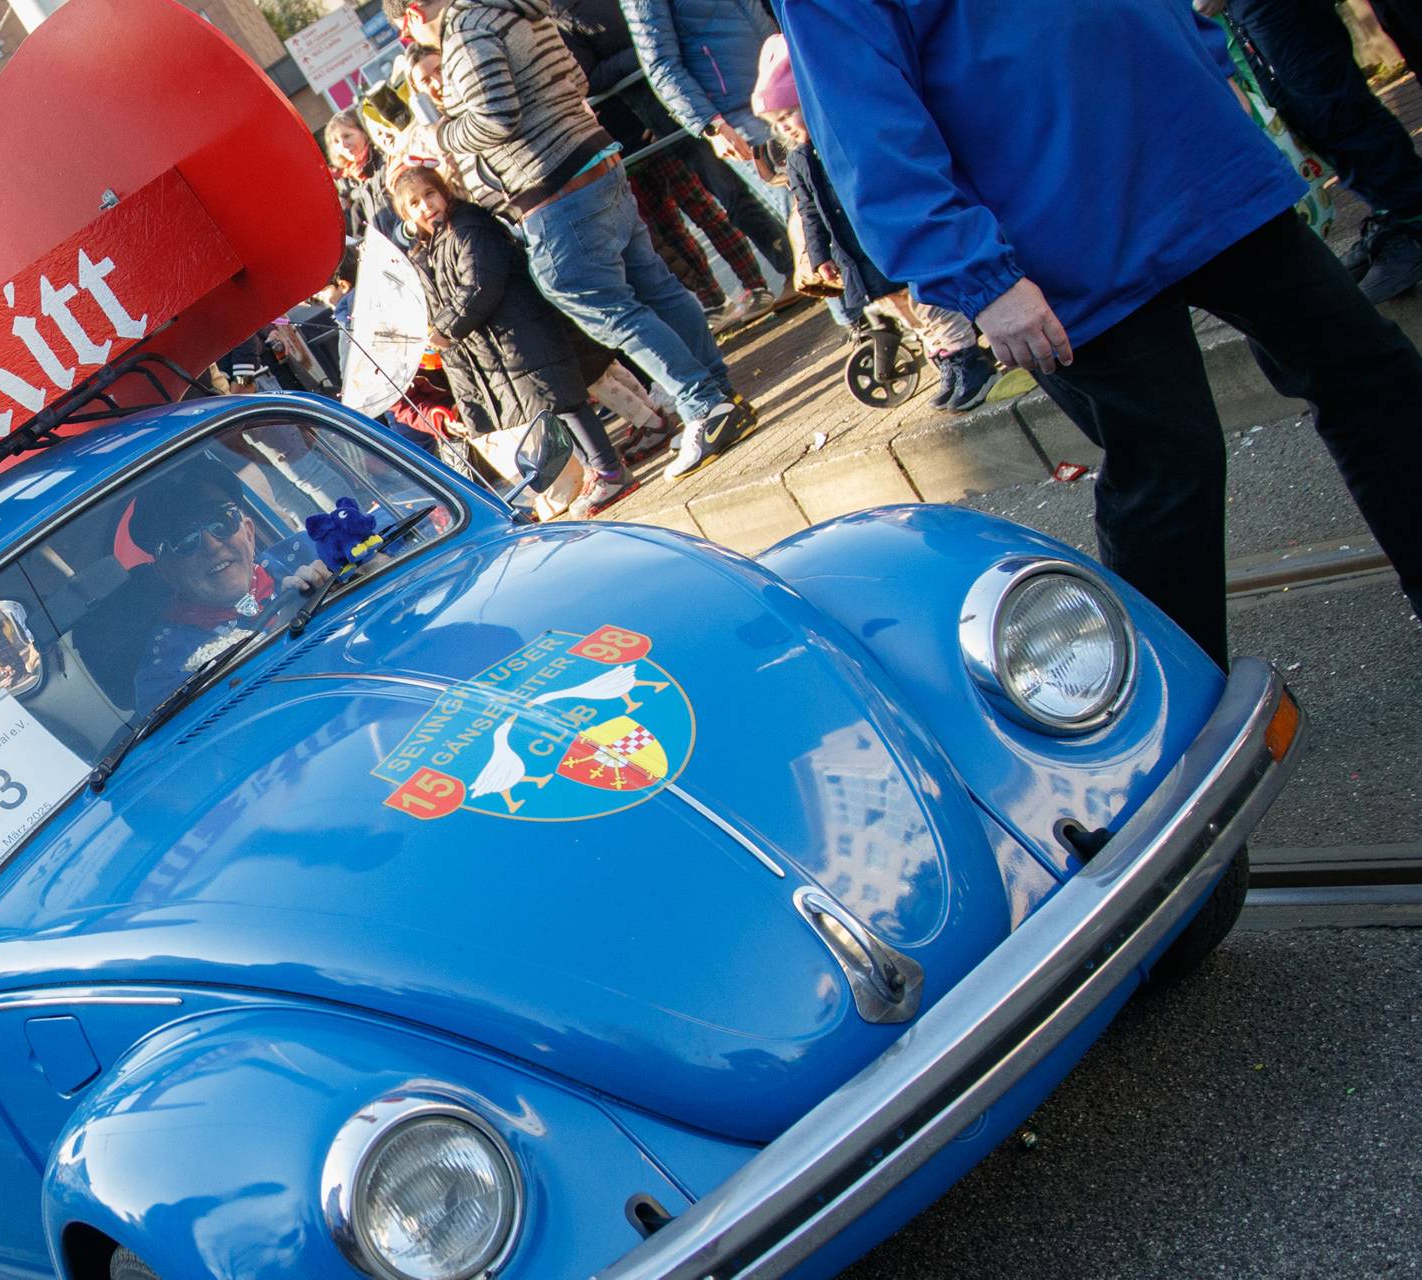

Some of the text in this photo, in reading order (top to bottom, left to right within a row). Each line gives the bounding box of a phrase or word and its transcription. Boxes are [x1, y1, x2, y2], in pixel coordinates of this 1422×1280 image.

[582, 631, 641, 661] 98
[387, 638, 565, 772] SEVINGHAUSER
[10, 720, 29, 737] e.V.
[529, 705, 598, 756] CLUB
[401, 774, 455, 810] 15
[2, 824, 27, 847] März
[26, 801, 52, 825] 2025
